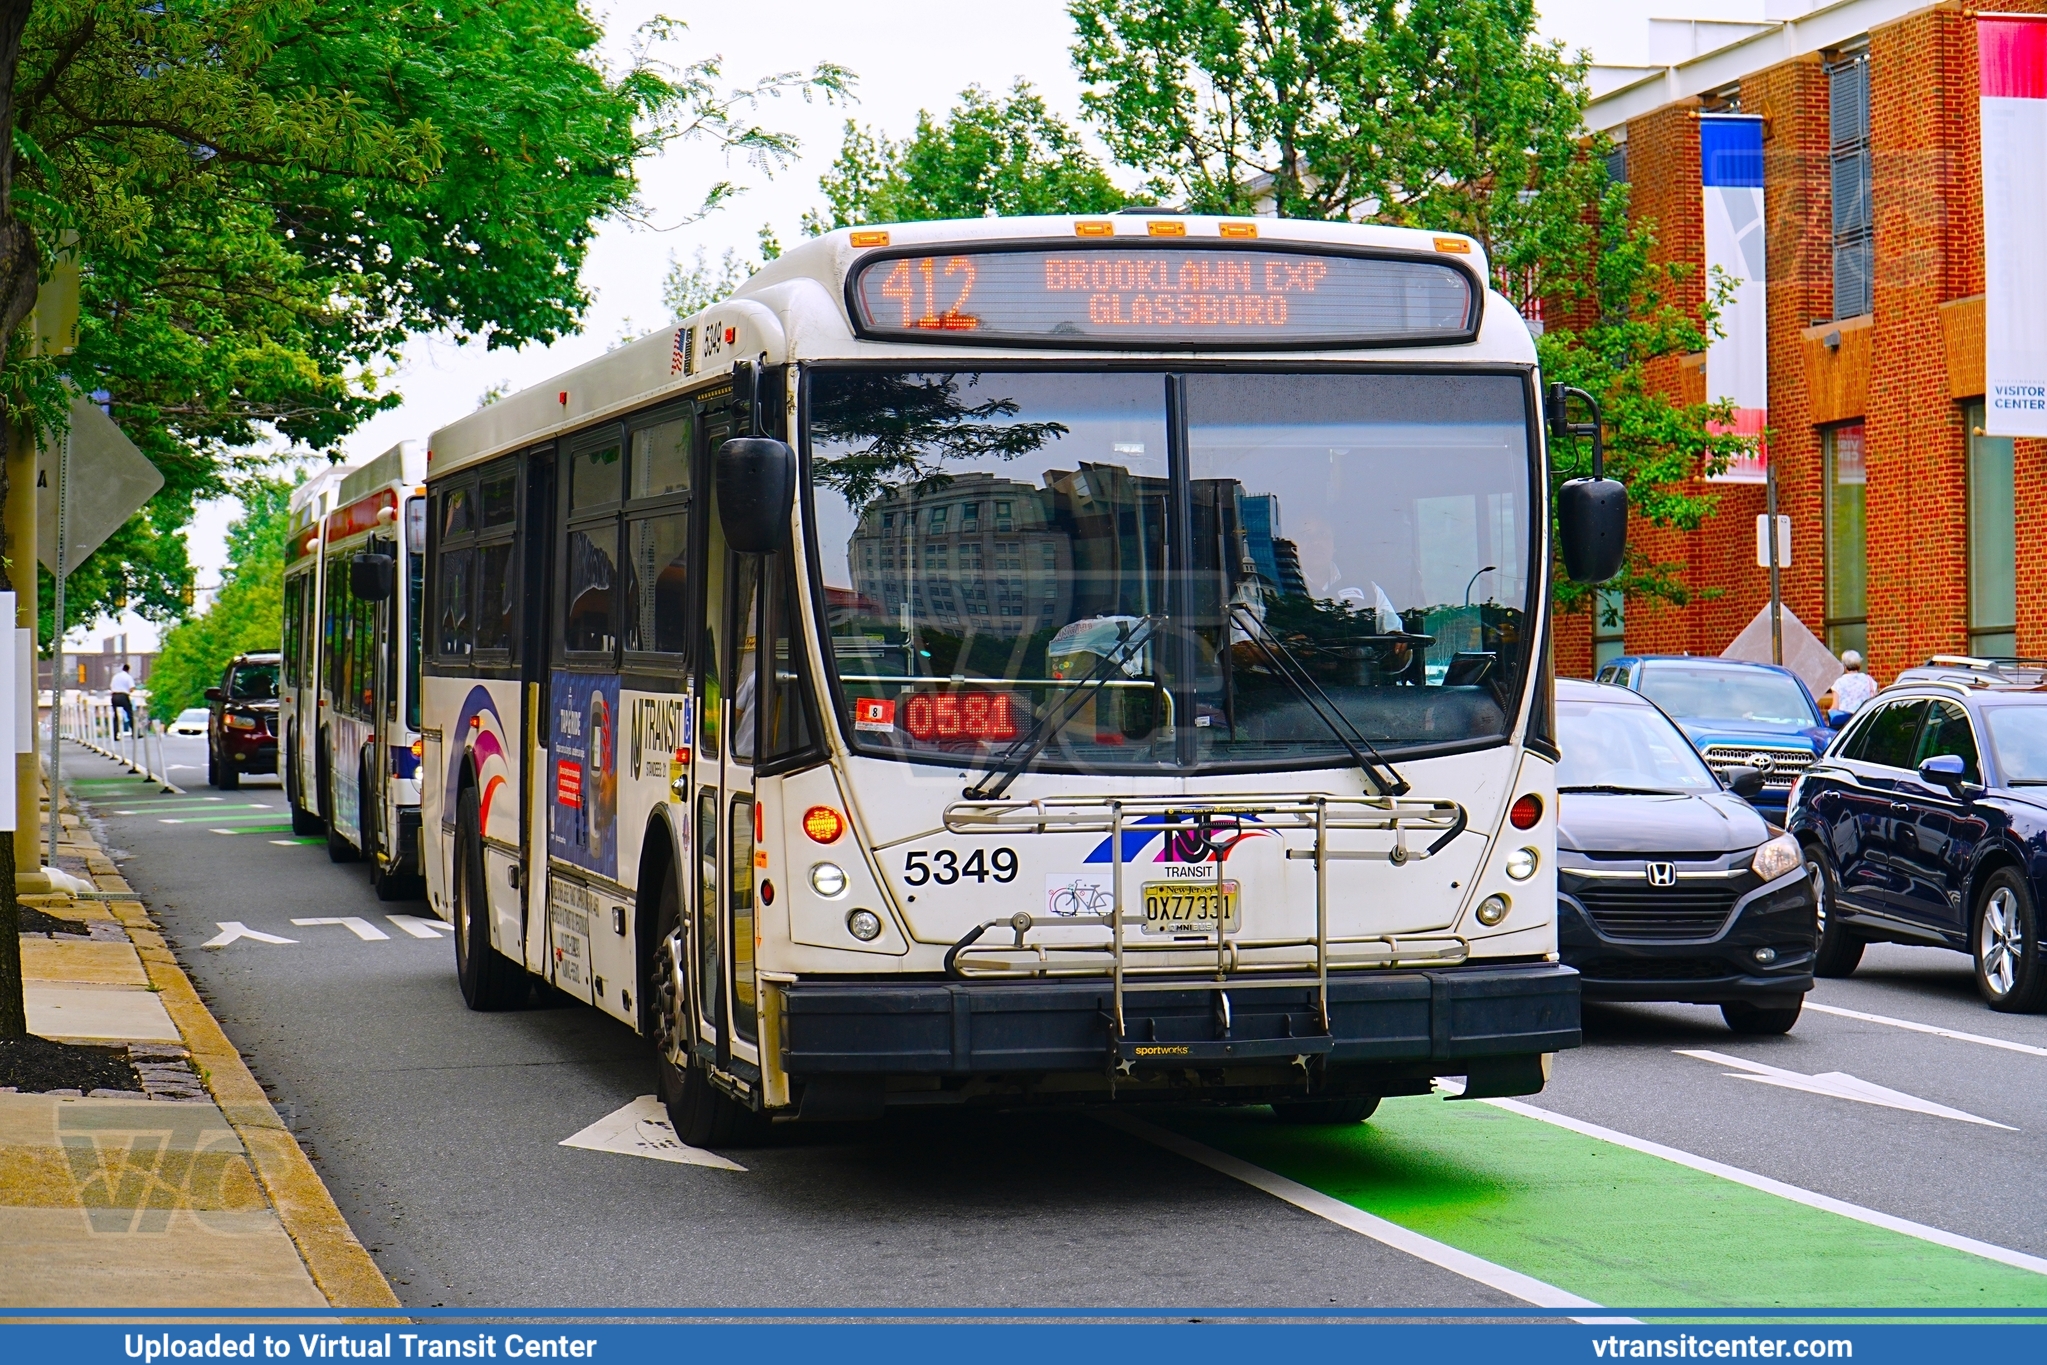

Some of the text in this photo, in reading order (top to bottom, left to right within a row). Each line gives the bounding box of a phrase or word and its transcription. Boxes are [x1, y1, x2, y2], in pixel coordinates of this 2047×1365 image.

[1045, 259, 1327, 292] BROOKLAWN EXP
[882, 258, 977, 330] 412
[1090, 294, 1288, 325] GLASSBORO
[704, 321, 722, 357] 5349
[1994, 398, 2046, 410] CENTER
[1995, 386, 2046, 397] VISITOR
[645, 698, 683, 754] TRANSIT
[872, 707, 878, 718] 8
[909, 696, 1013, 734] 0581
[903, 847, 1019, 887] 5349
[1164, 866, 1213, 878] TRANSIT
[1166, 885, 1187, 894] New
[201, 914, 455, 947] NLY
[1168, 923, 1214, 932] OMNIBUS
[1135, 1046, 1188, 1056] sportworks
